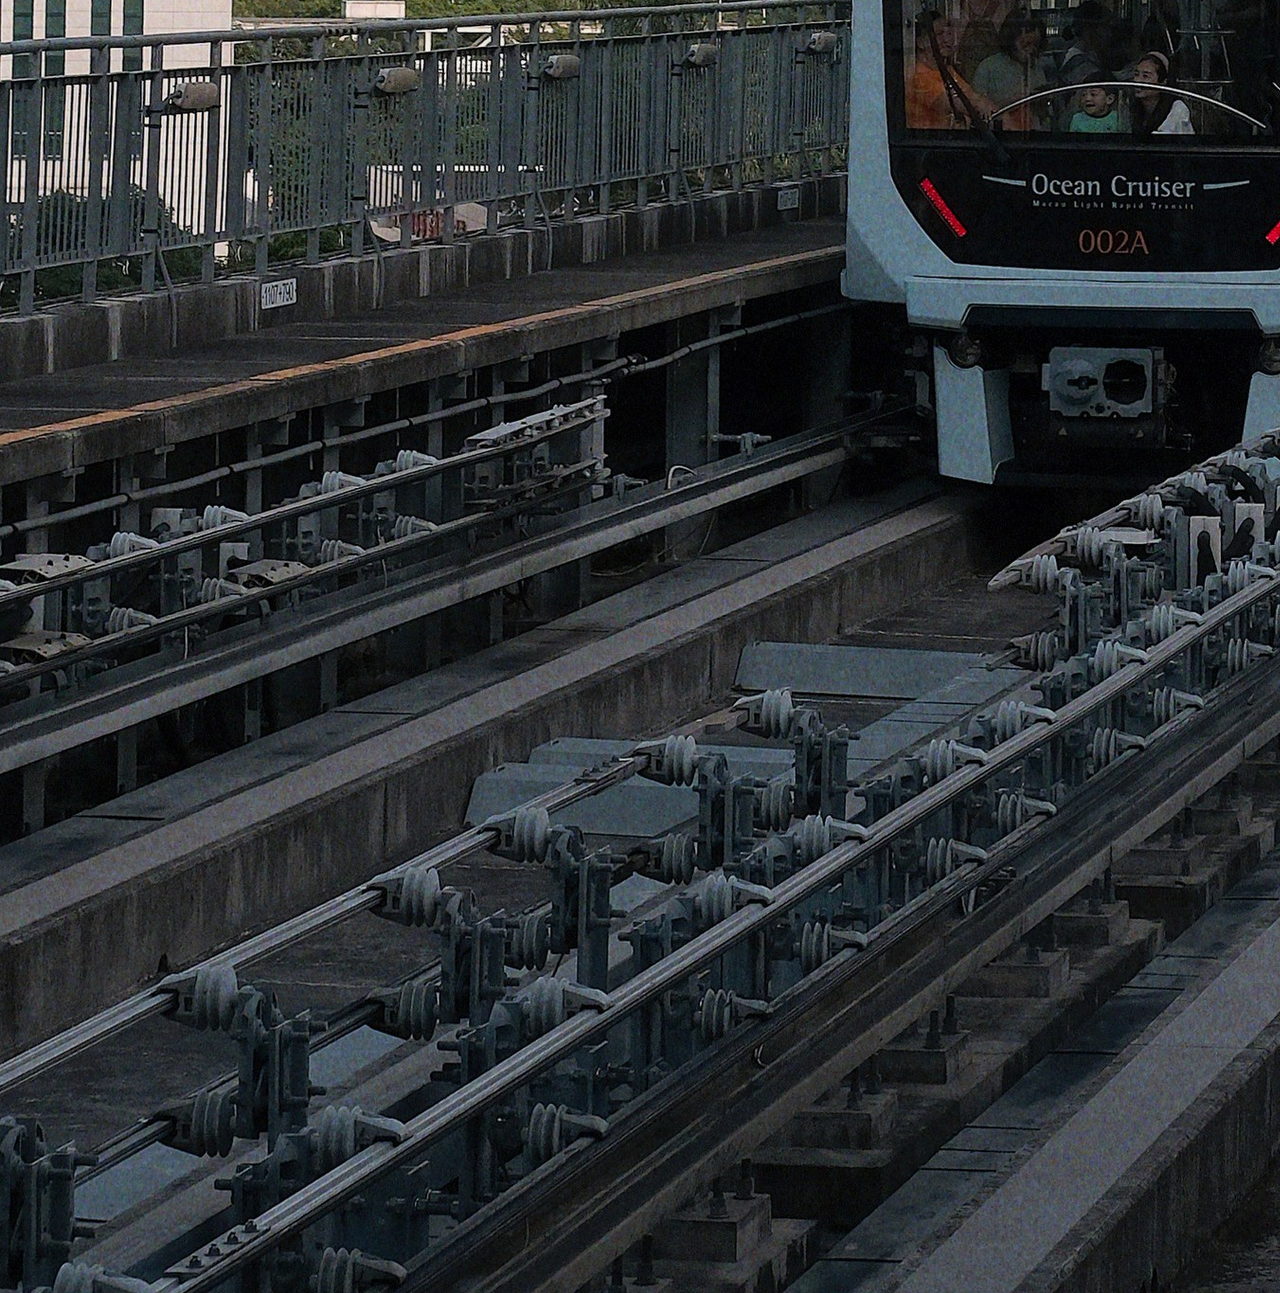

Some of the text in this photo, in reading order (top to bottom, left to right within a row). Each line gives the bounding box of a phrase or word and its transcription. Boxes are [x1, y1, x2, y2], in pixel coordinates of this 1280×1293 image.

[1031, 173, 1196, 198] Ocean Cruiser
[1078, 229, 1150, 255] 002A
